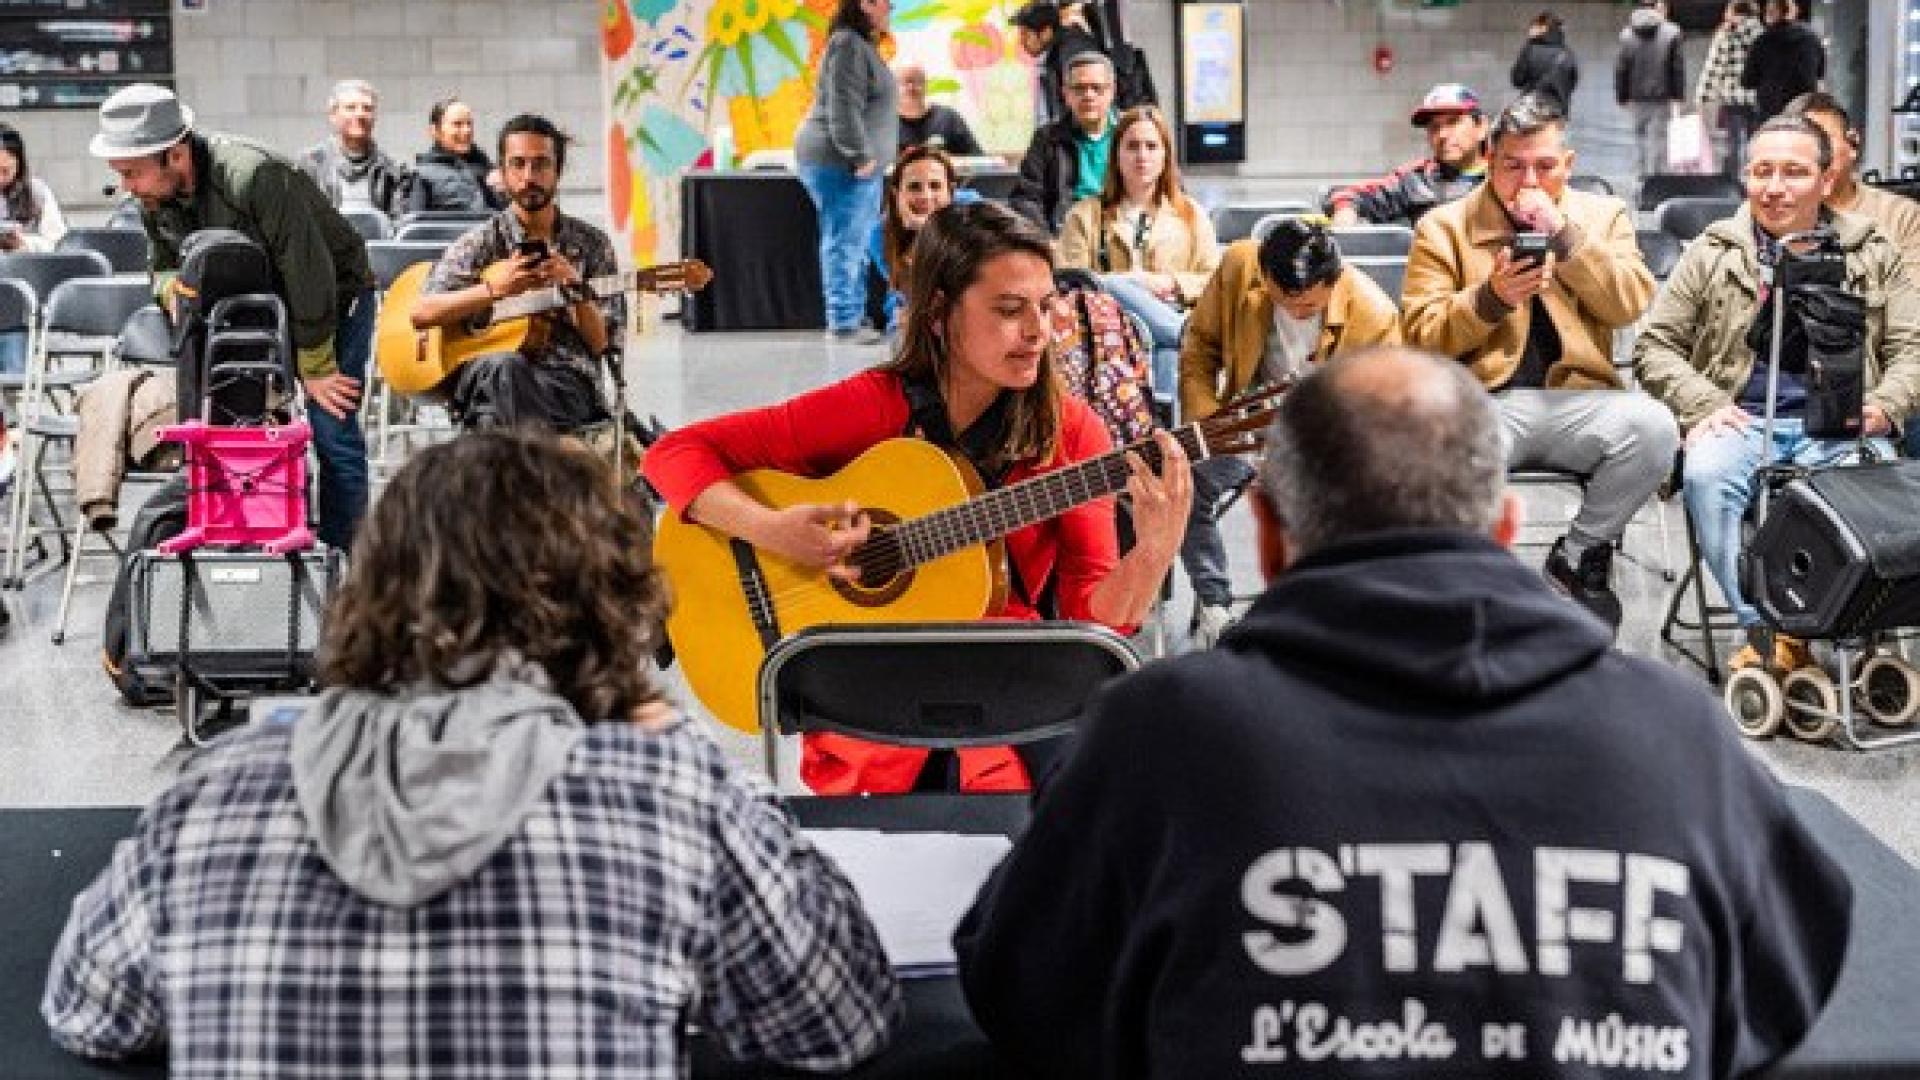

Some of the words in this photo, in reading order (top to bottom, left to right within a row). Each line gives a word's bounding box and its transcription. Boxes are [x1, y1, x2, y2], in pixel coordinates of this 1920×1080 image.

[1241, 841, 1691, 984] STAFF
[1241, 997, 1457, 1064] L'Escola
[1482, 1021, 1527, 1060] DE
